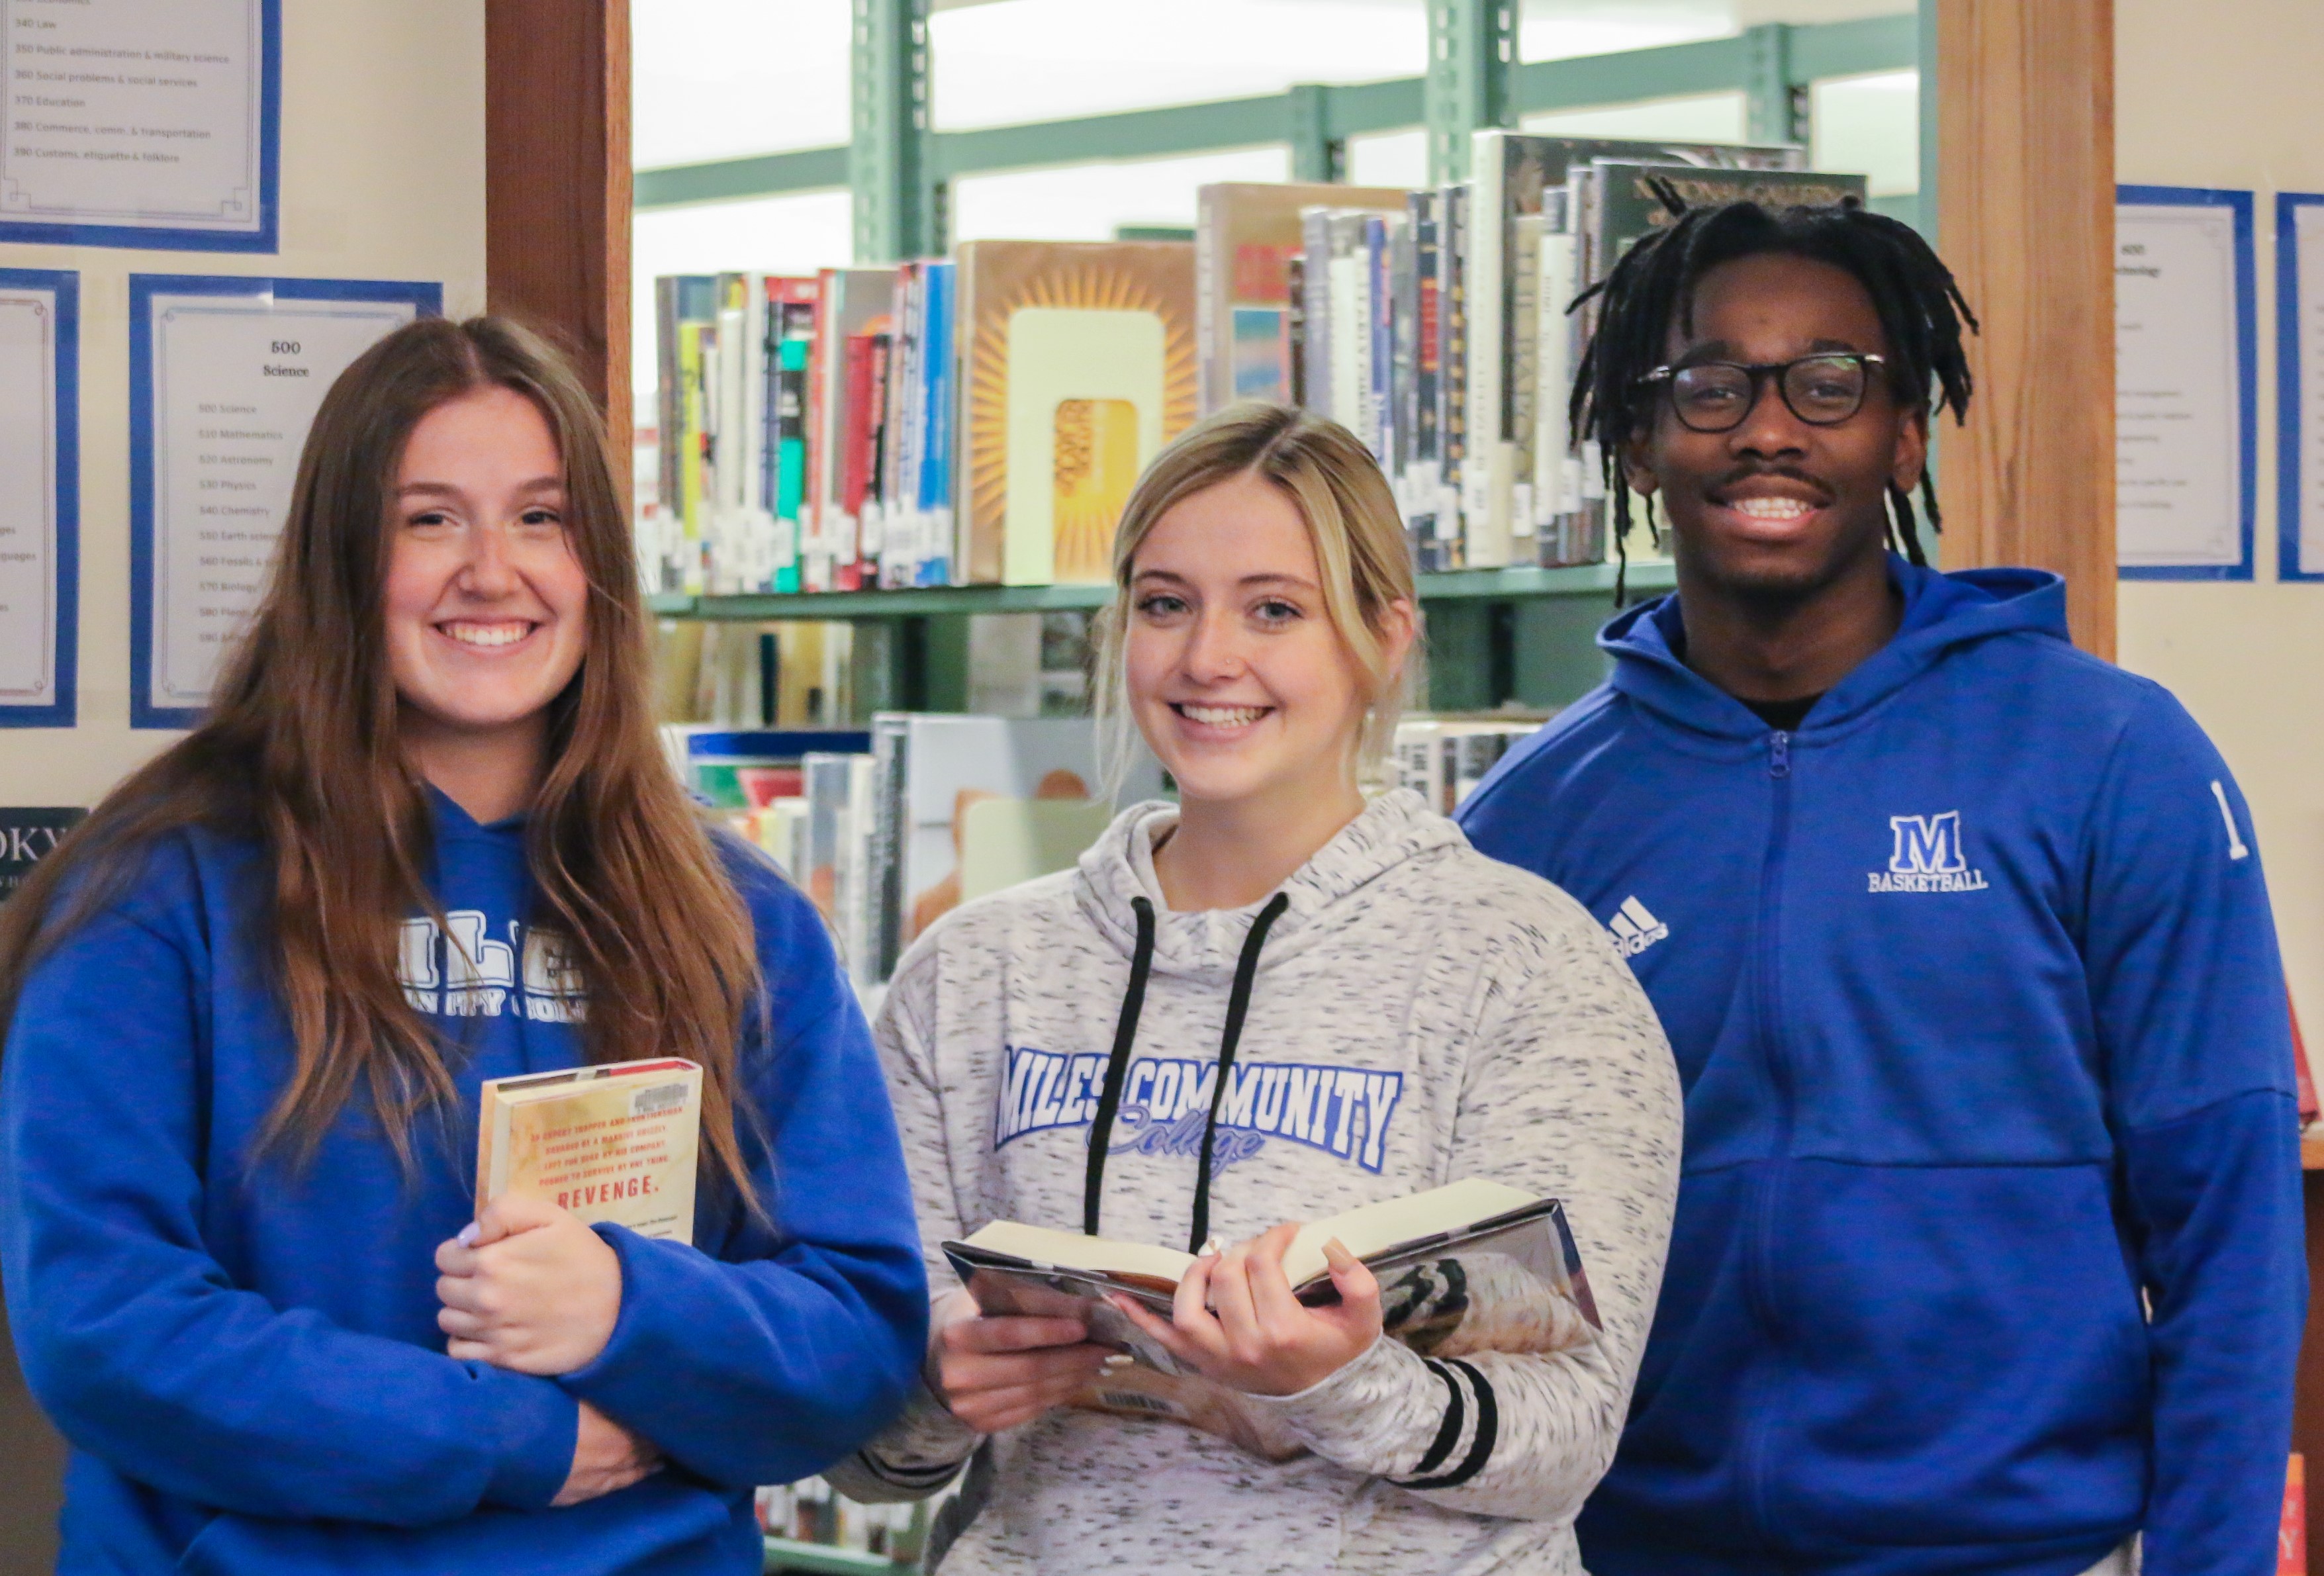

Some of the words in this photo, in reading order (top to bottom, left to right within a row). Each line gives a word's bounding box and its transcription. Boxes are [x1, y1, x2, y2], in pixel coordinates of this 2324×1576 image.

[15, 18, 34, 28] 340
[36, 19, 58, 29] Law
[36, 46, 66, 56] Public
[70, 48, 142, 59] administration
[154, 51, 191, 64] military
[193, 54, 230, 64] science
[36, 71, 66, 81] Social
[68, 73, 115, 84] problems
[128, 76, 156, 86] social
[158, 77, 198, 87] services
[36, 96, 86, 107] Education
[141, 127, 211, 140] transportation
[83, 150, 130, 162] etiquette
[142, 152, 180, 163] folklore
[271, 340, 301, 354] 500
[263, 364, 309, 377] Science
[219, 404, 257, 414] Science
[220, 430, 283, 440] Mathematics
[220, 455, 274, 467] Astronomy
[221, 481, 257, 492] Physics
[222, 506, 271, 518] Chemistry
[221, 531, 248, 541] Earth
[221, 557, 254, 567] Fossils
[221, 582, 257, 594] Biology
[1889, 810, 1967, 874] M
[1867, 868, 1989, 893] BASKETBALL
[1121, 1057, 1403, 1174] COMMUNITY
[609, 1117, 625, 1127] AND
[557, 1175, 659, 1211] REVENGE.
